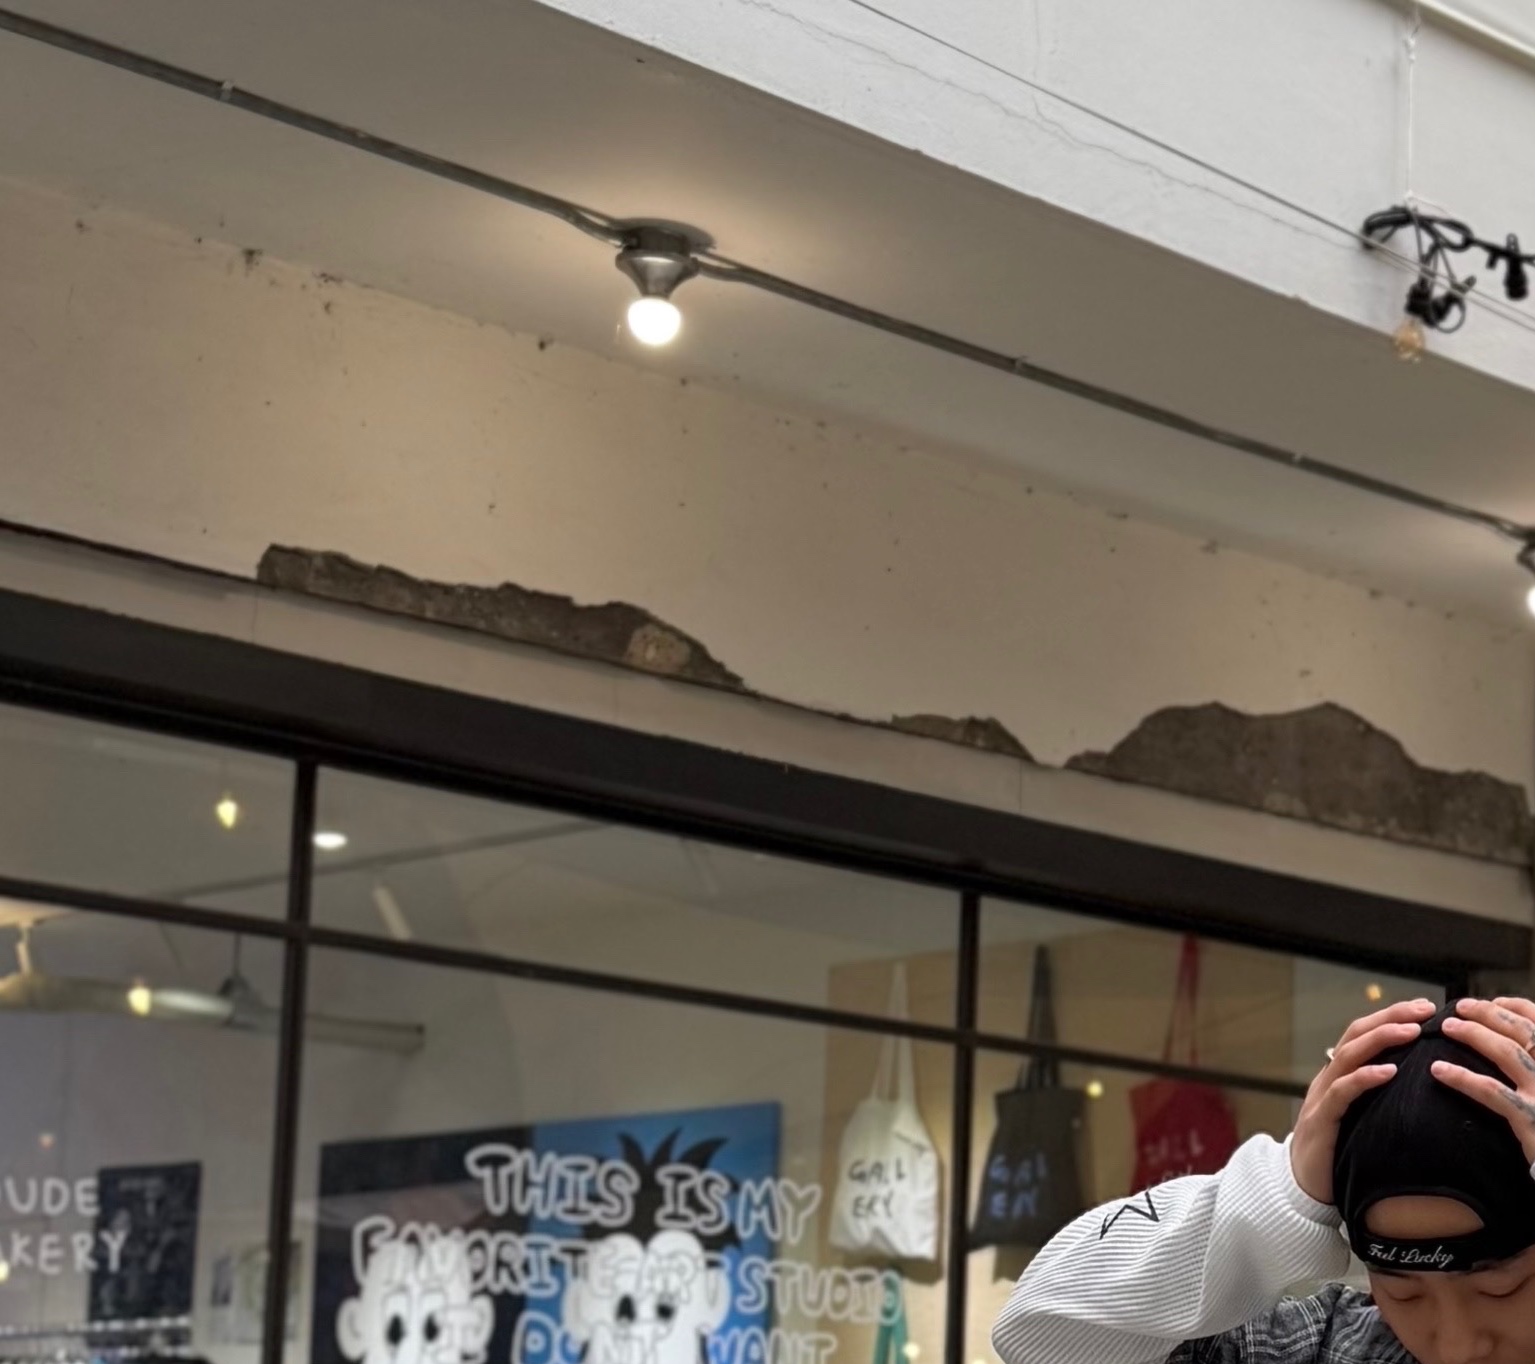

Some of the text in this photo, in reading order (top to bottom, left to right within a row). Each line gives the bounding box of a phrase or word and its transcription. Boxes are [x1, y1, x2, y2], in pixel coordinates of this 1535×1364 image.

[0, 1175, 102, 1216] UDE
[465, 1143, 822, 1244] THIS IS MY
[0, 1231, 130, 1276] KERY
[352, 1215, 622, 1300] FAVORITE
[735, 1256, 902, 1325] STUDIO
